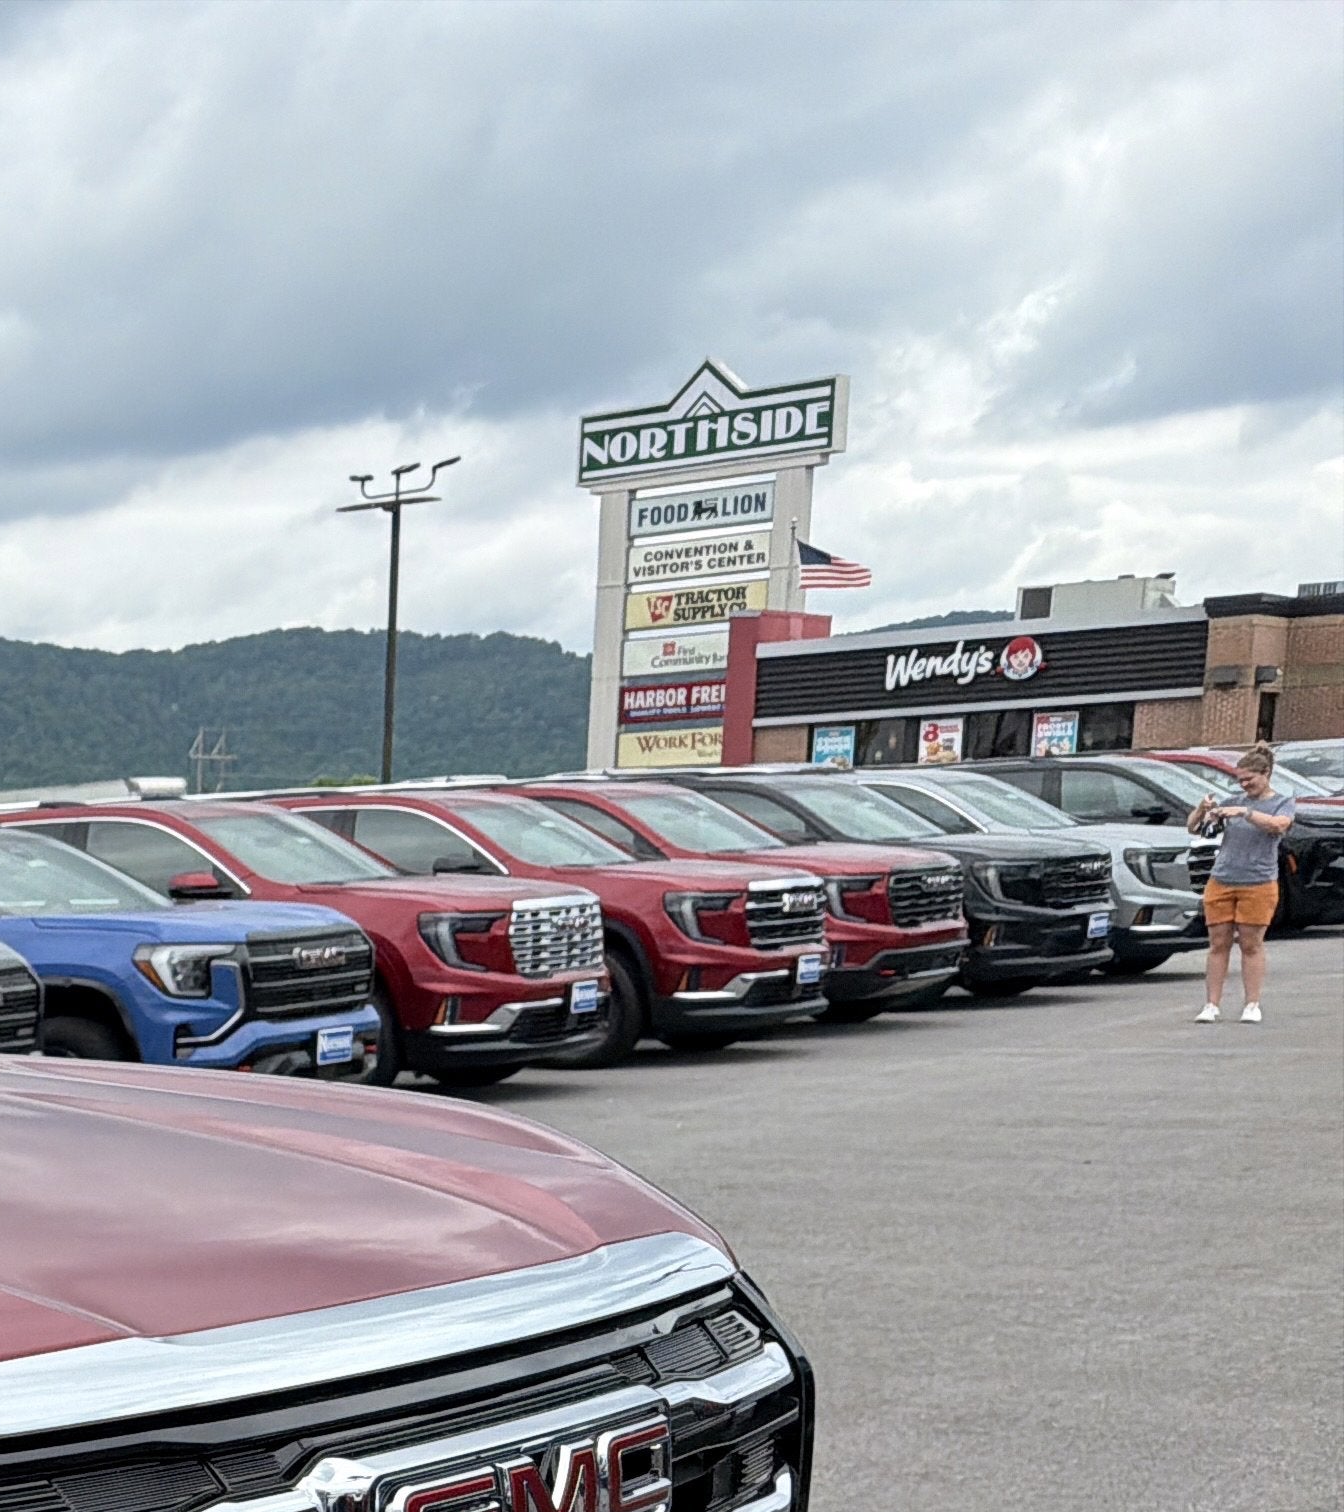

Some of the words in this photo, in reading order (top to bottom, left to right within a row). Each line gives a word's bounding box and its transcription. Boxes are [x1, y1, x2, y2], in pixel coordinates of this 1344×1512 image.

[581, 400, 830, 468] NORTHSIDE
[637, 503, 689, 528] FOOD
[720, 492, 767, 517] LION
[632, 559, 703, 578] VISITOR'S
[706, 551, 766, 570] CENTER
[643, 541, 739, 563] CONVENTION
[743, 539, 754, 551] &
[673, 585, 748, 607] TRACTOR
[673, 602, 728, 622] SUPPLY
[884, 640, 996, 692] Wendy's
[623, 685, 689, 711] HARBOR
[691, 683, 726, 706] FREI
[636, 732, 689, 755] WORK
[690, 731, 724, 753] FOR
